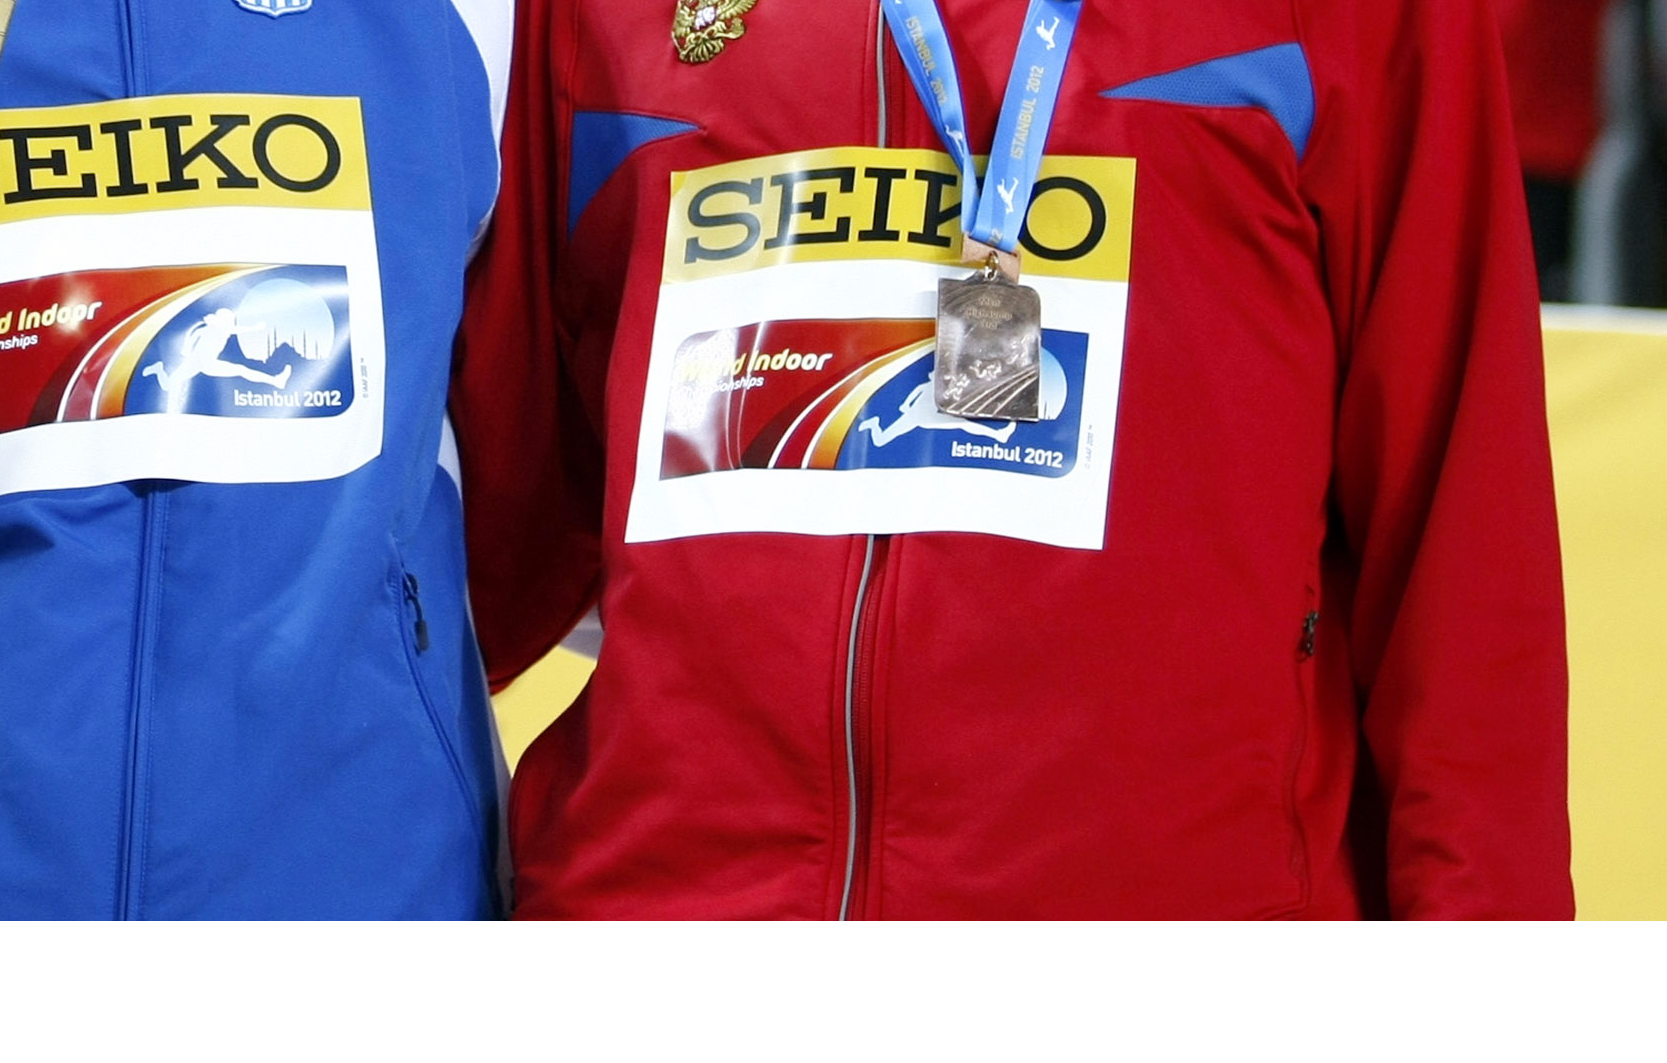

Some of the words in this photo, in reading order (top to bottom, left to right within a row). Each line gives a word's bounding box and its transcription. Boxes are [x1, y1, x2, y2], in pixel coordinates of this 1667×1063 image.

[904, 15, 933, 78] ISTANBUL
[1010, 97, 1037, 160] ISTANBUL
[1026, 65, 1045, 95] 2012
[17, 302, 102, 332] Indoor
[747, 348, 833, 371] Indoor
[234, 389, 301, 407] Istanbul
[303, 390, 342, 407] 2012
[951, 441, 1021, 462] Istanbul
[1024, 448, 1063, 468] 2012
